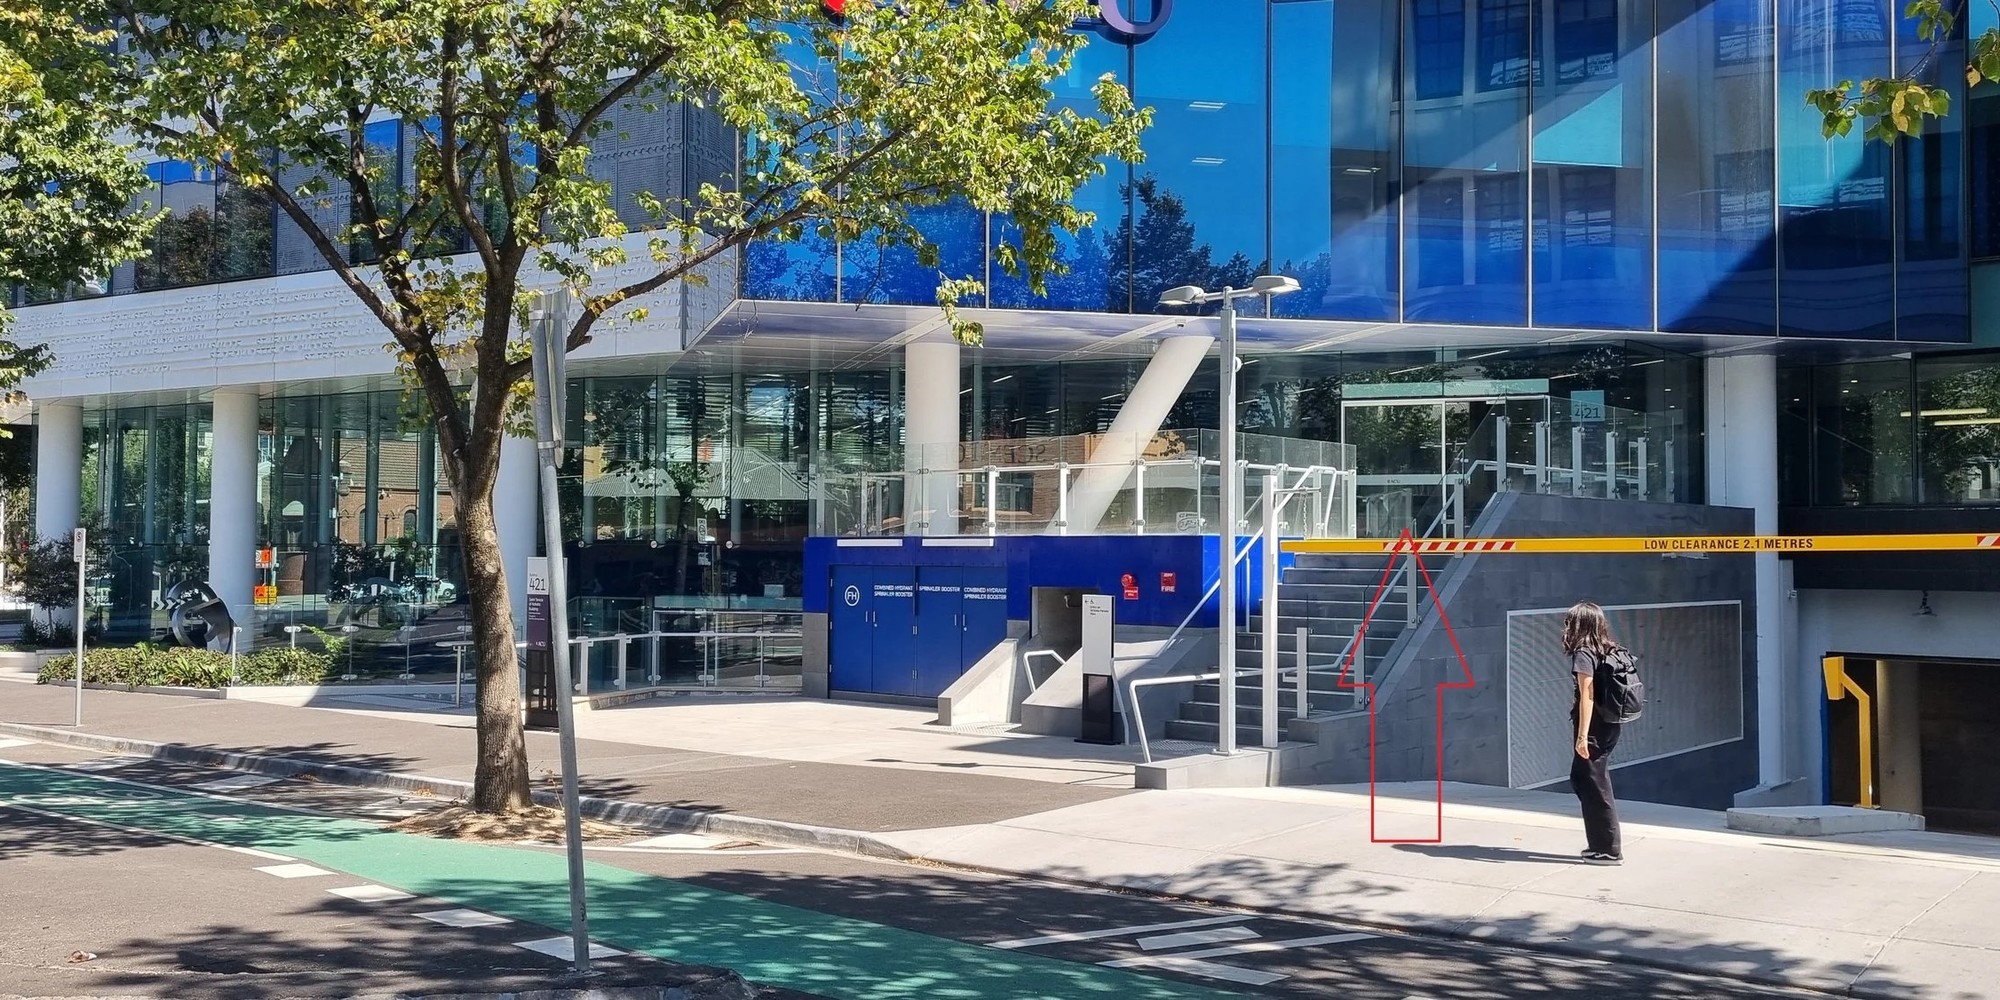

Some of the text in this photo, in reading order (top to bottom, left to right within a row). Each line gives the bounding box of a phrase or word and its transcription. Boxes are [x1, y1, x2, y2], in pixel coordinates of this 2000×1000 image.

[1574, 407, 1601, 419] 421
[1644, 538, 1813, 550] LOW CLEARANCE 2.1 METRES
[529, 577, 546, 591] 421
[847, 591, 857, 600] FH
